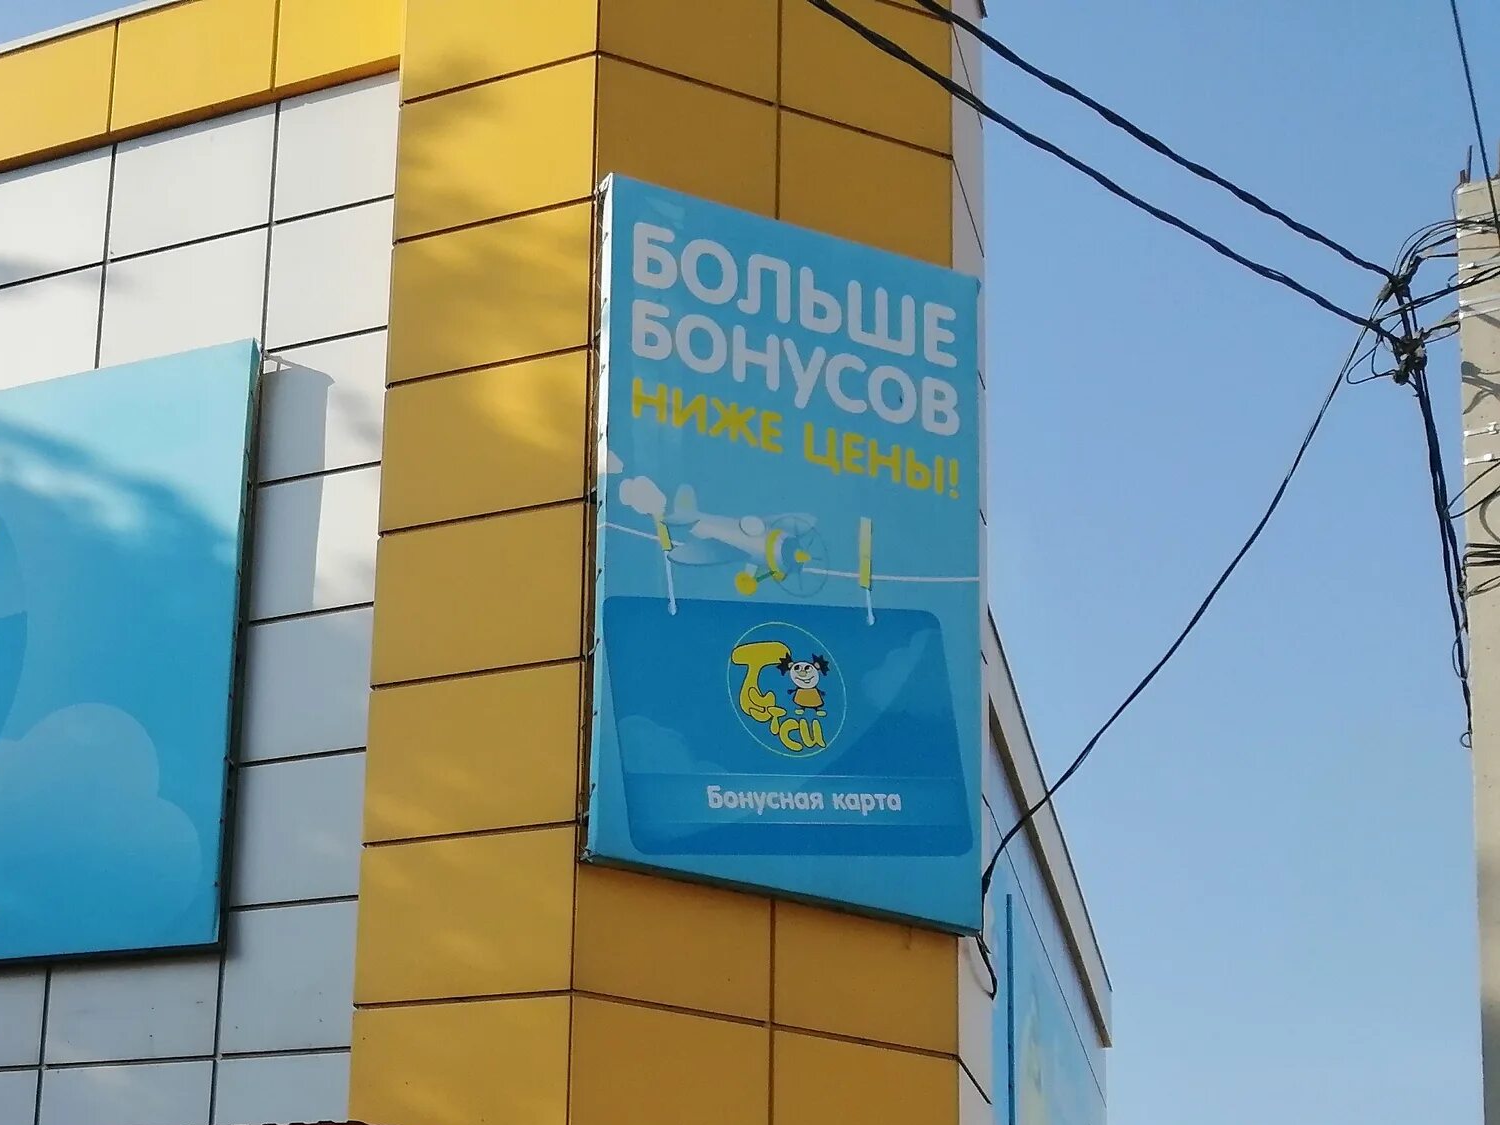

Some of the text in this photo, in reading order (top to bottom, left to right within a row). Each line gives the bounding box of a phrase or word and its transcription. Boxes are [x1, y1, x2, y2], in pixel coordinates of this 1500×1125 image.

[633, 222, 958, 368] БОЛЬШЕ
[632, 300, 960, 436] БОНУСОВ
[632, 377, 959, 499] НИЖЕ ЦЕНЫ!
[706, 785, 902, 816] Бонусная карта
